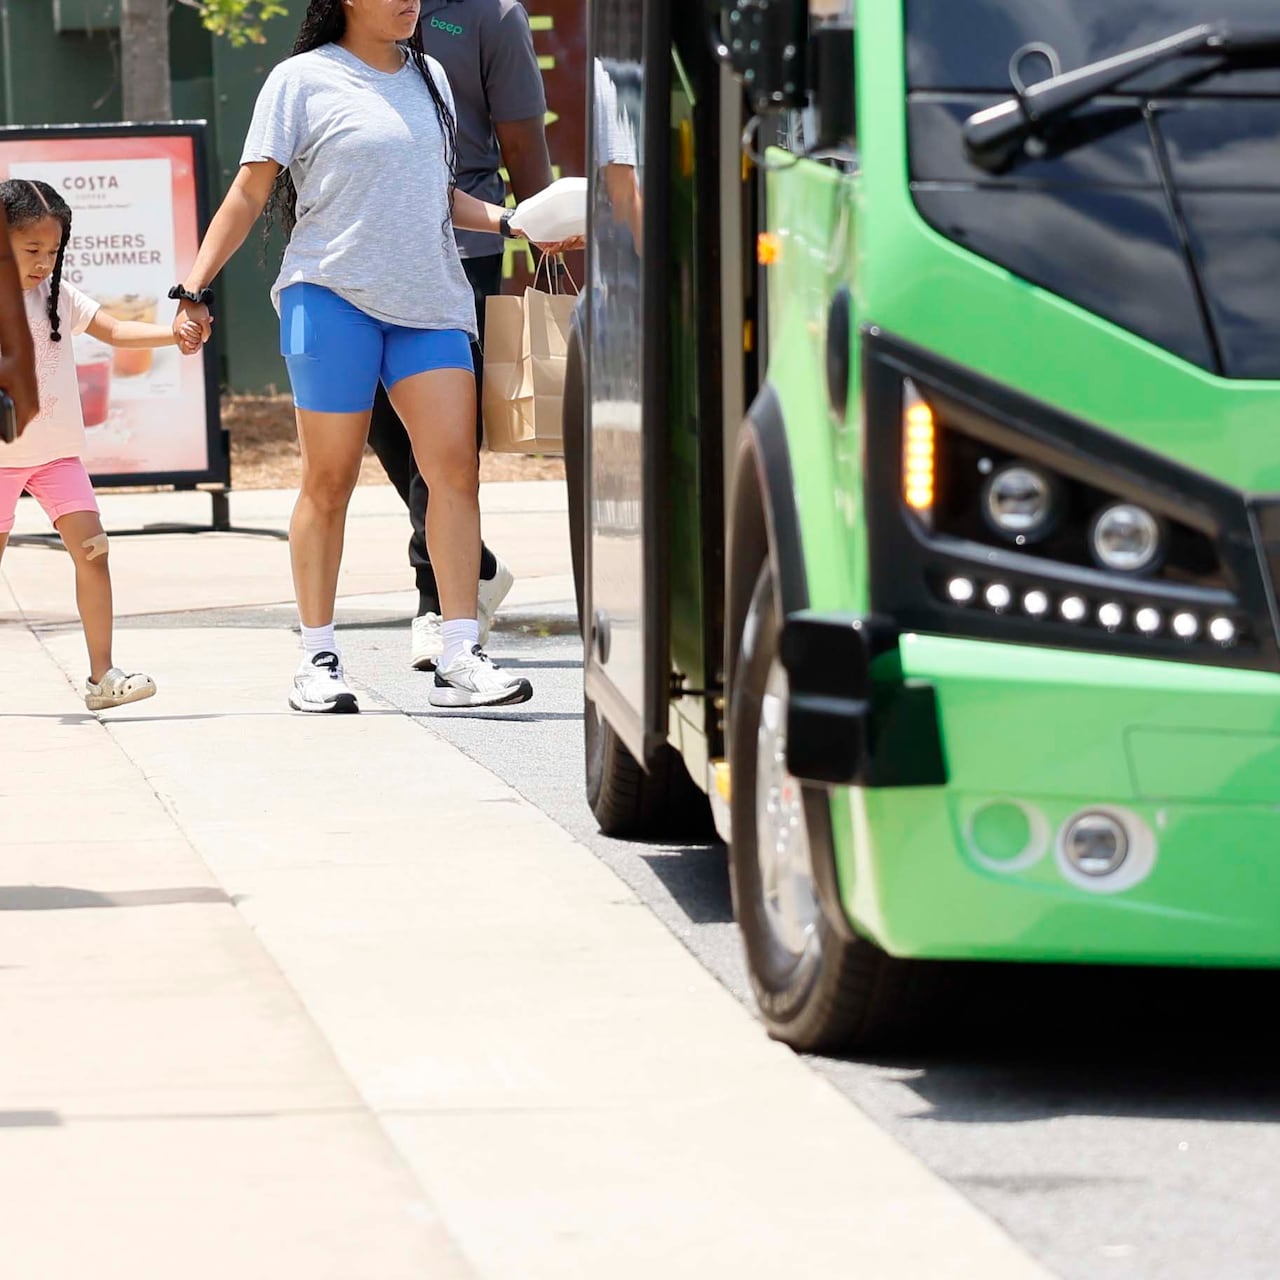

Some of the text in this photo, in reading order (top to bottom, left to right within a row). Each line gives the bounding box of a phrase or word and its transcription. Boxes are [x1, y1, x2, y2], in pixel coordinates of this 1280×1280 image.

[430, 16, 463, 36] beep
[62, 175, 119, 191] COSTA
[81, 250, 161, 267] SUMMER
